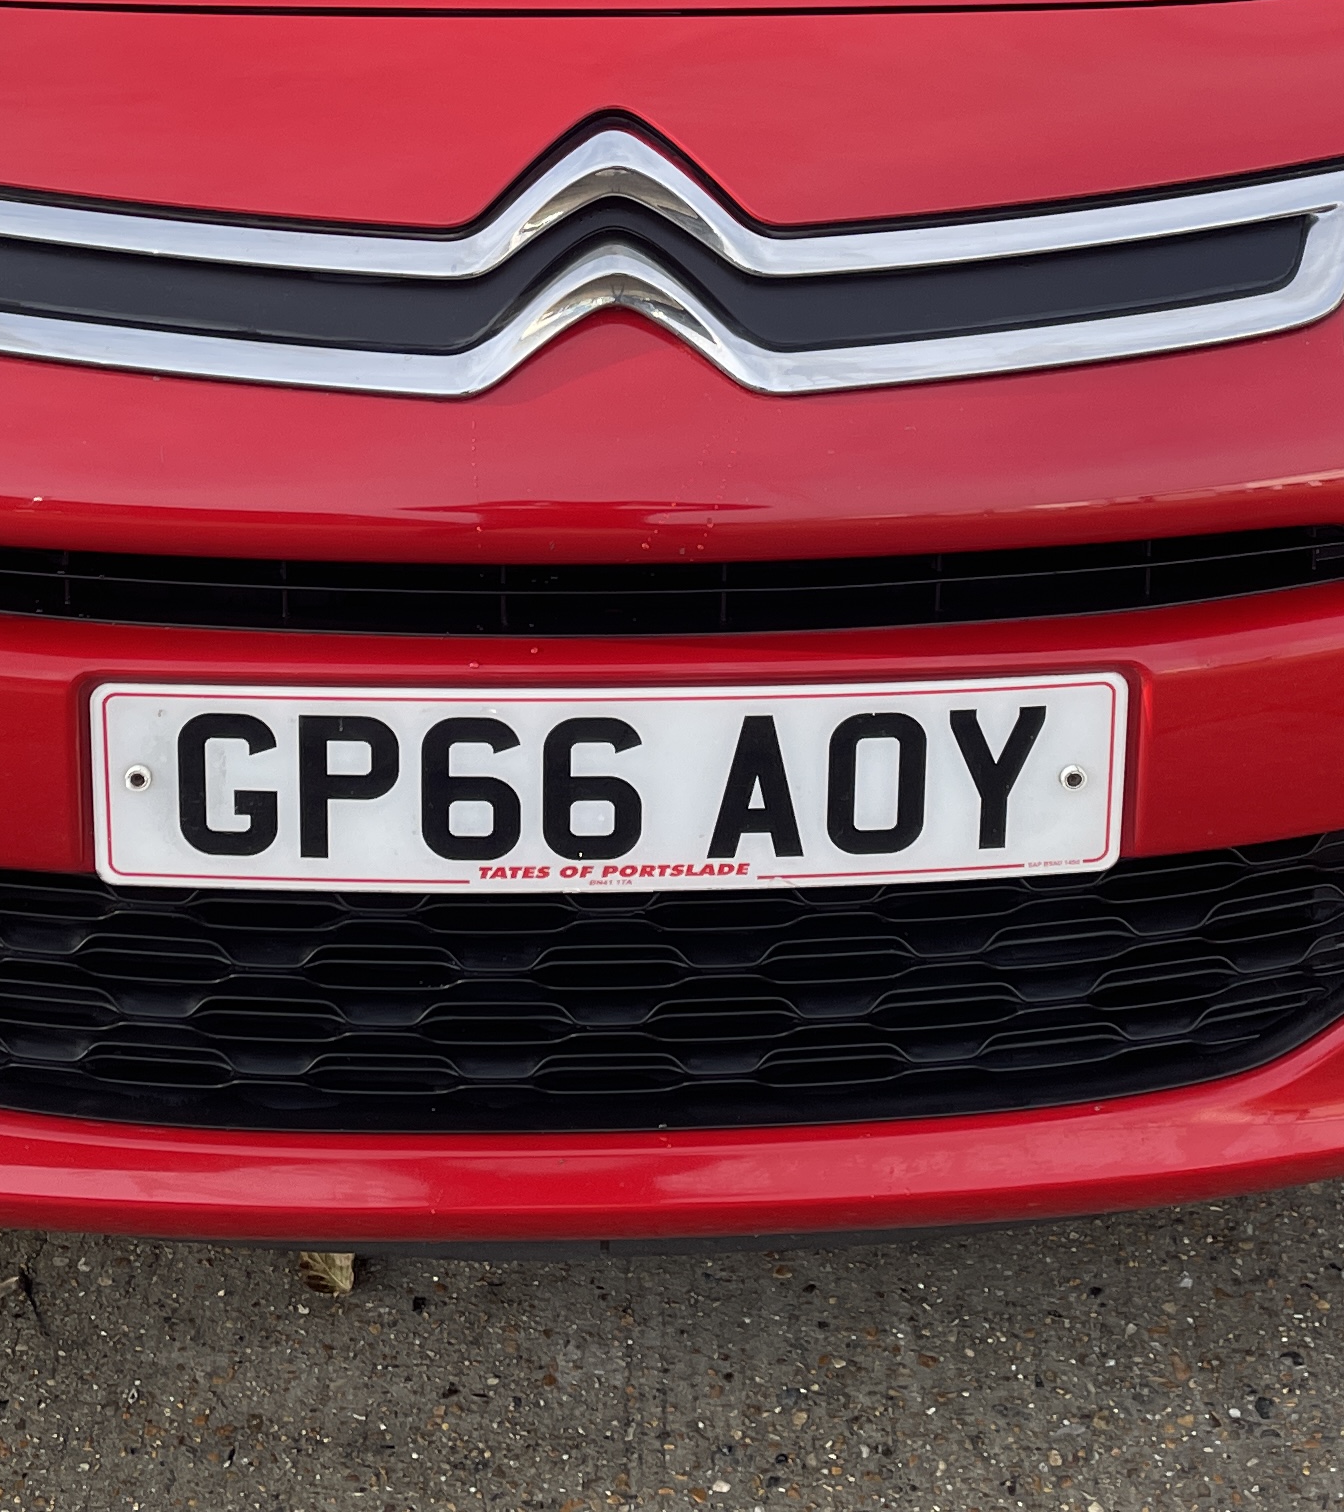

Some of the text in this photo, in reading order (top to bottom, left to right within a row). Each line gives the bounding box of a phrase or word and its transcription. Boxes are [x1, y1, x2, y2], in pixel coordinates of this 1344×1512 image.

[177, 705, 1047, 861] GP66 AOY
[478, 863, 751, 879] TATES OF PORTSLADE
